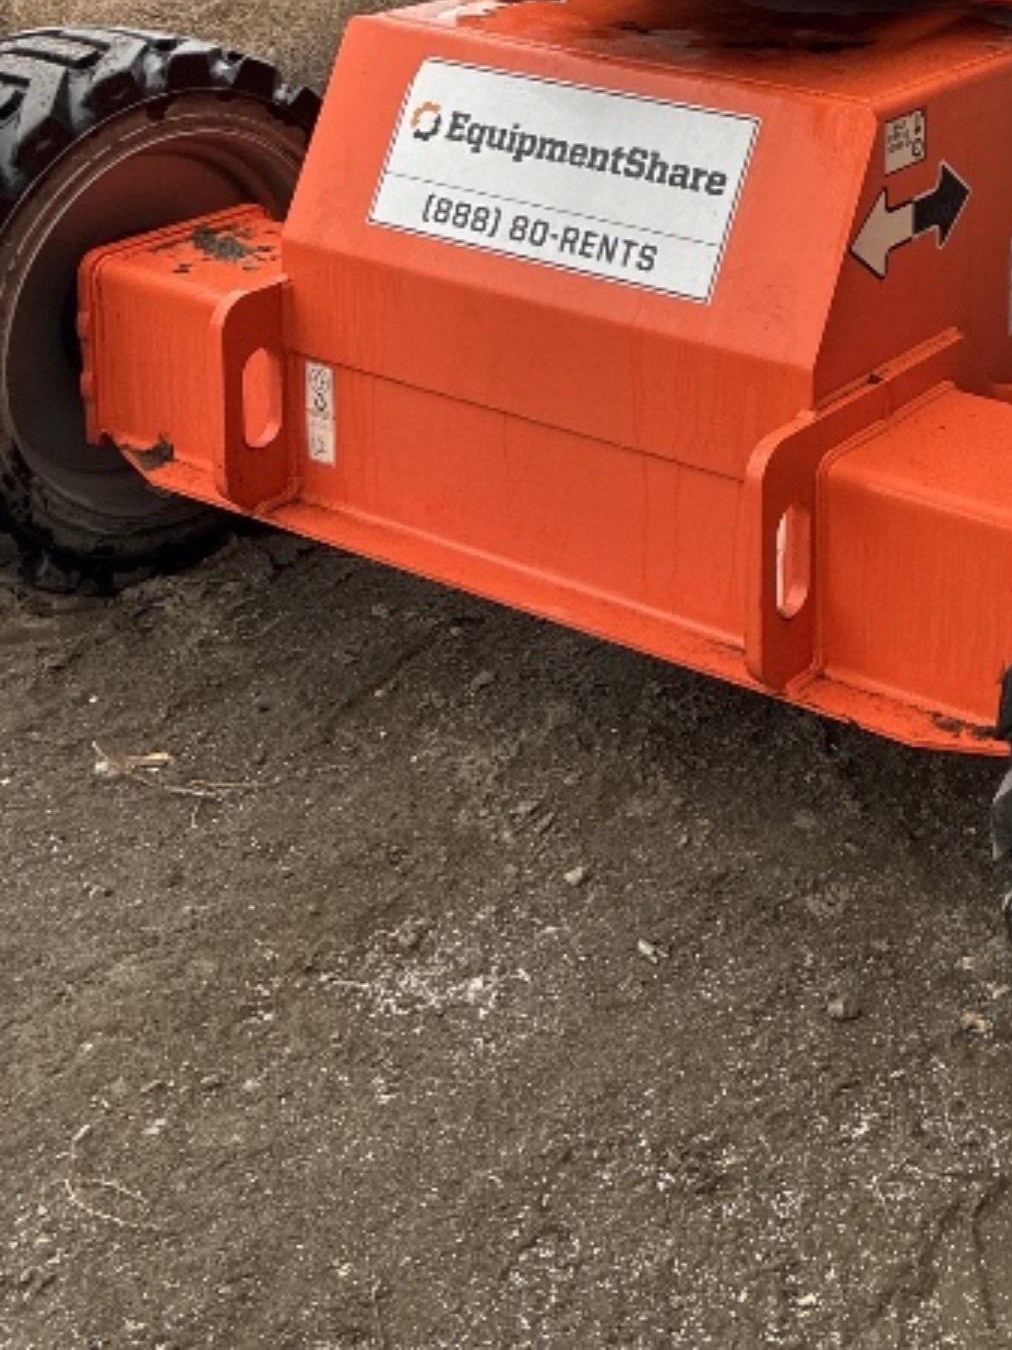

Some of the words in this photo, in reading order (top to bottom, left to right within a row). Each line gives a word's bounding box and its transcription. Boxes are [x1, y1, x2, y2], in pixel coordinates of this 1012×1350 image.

[445, 110, 728, 197] EquipmentShare
[422, 193, 501, 238] (888)
[509, 214, 659, 273] 80-RENTS
